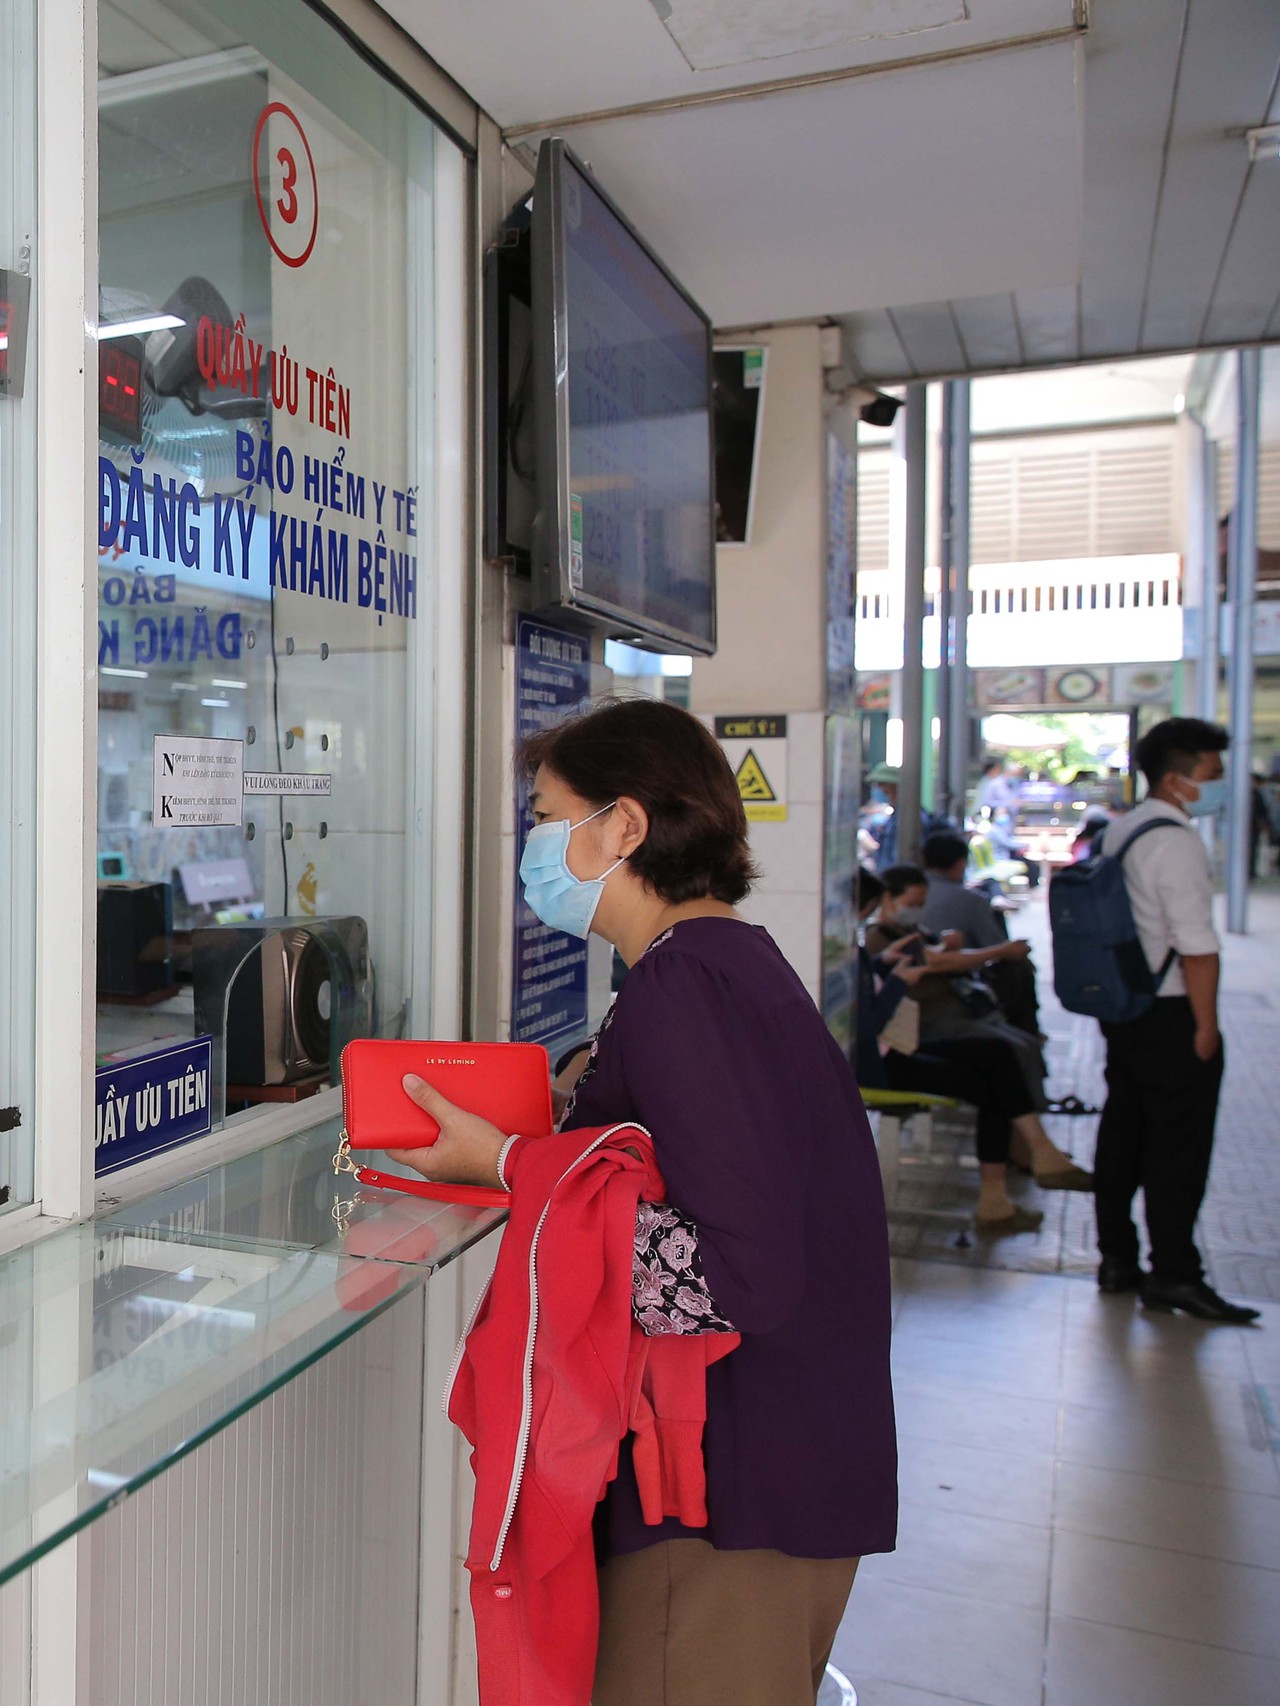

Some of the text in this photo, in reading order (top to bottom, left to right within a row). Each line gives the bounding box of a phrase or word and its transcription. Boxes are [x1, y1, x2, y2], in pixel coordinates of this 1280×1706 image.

[275, 146, 298, 225] 3
[196, 311, 351, 440] QUẦY ƯU TIÊN
[98, 446, 201, 571] ĐĂNG
[213, 484, 257, 580] KÝ
[269, 507, 349, 604] KHÁM
[357, 528, 418, 626] BỆNH
[235, 419, 419, 538] BẢO HIỂM Y TẾ
[135, 1082, 162, 1132] ƯU
[167, 1063, 207, 1120] TIÊN
